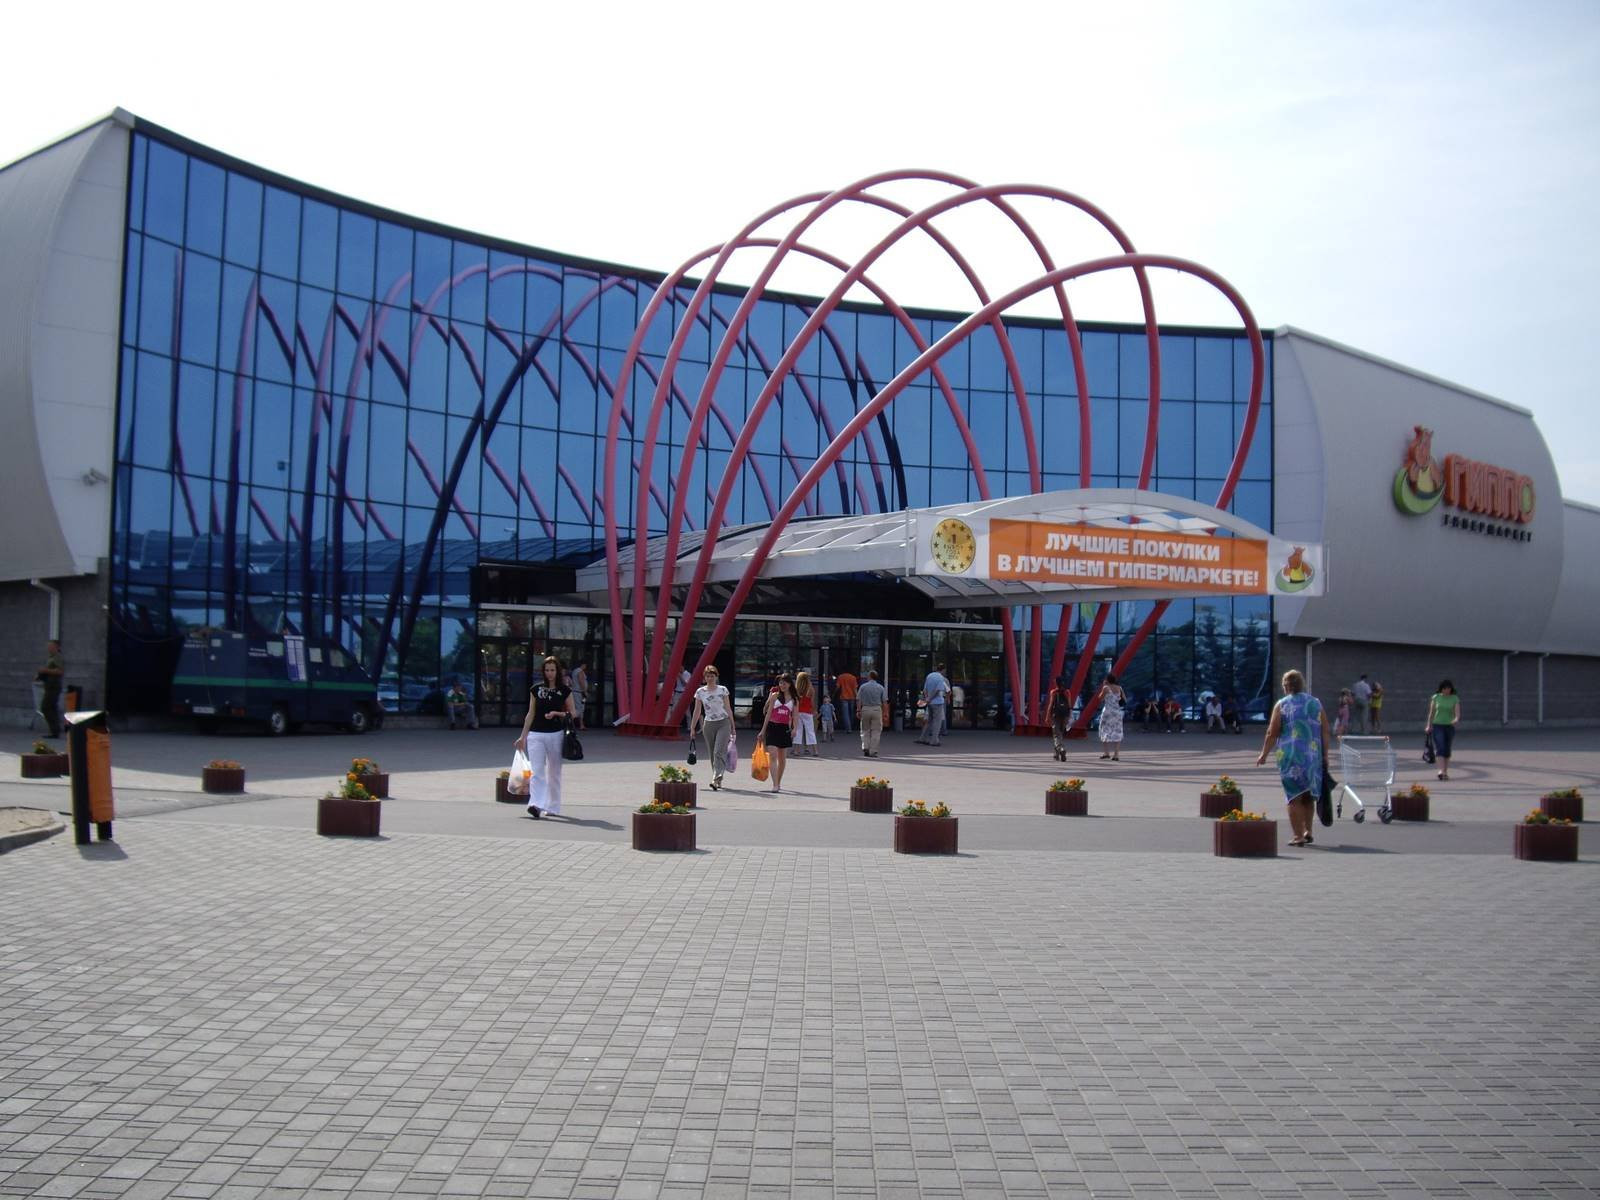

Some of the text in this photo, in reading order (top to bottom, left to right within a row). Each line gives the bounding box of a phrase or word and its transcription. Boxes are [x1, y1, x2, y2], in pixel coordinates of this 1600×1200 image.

[1444, 454, 1535, 524] ГИППО
[1045, 532, 1220, 561] ЛУЧШИЕ ПОКУПКИ
[998, 554, 1259, 586] В ЛУЧШЕМ ГИПЕРМАРКЕТЕ!
